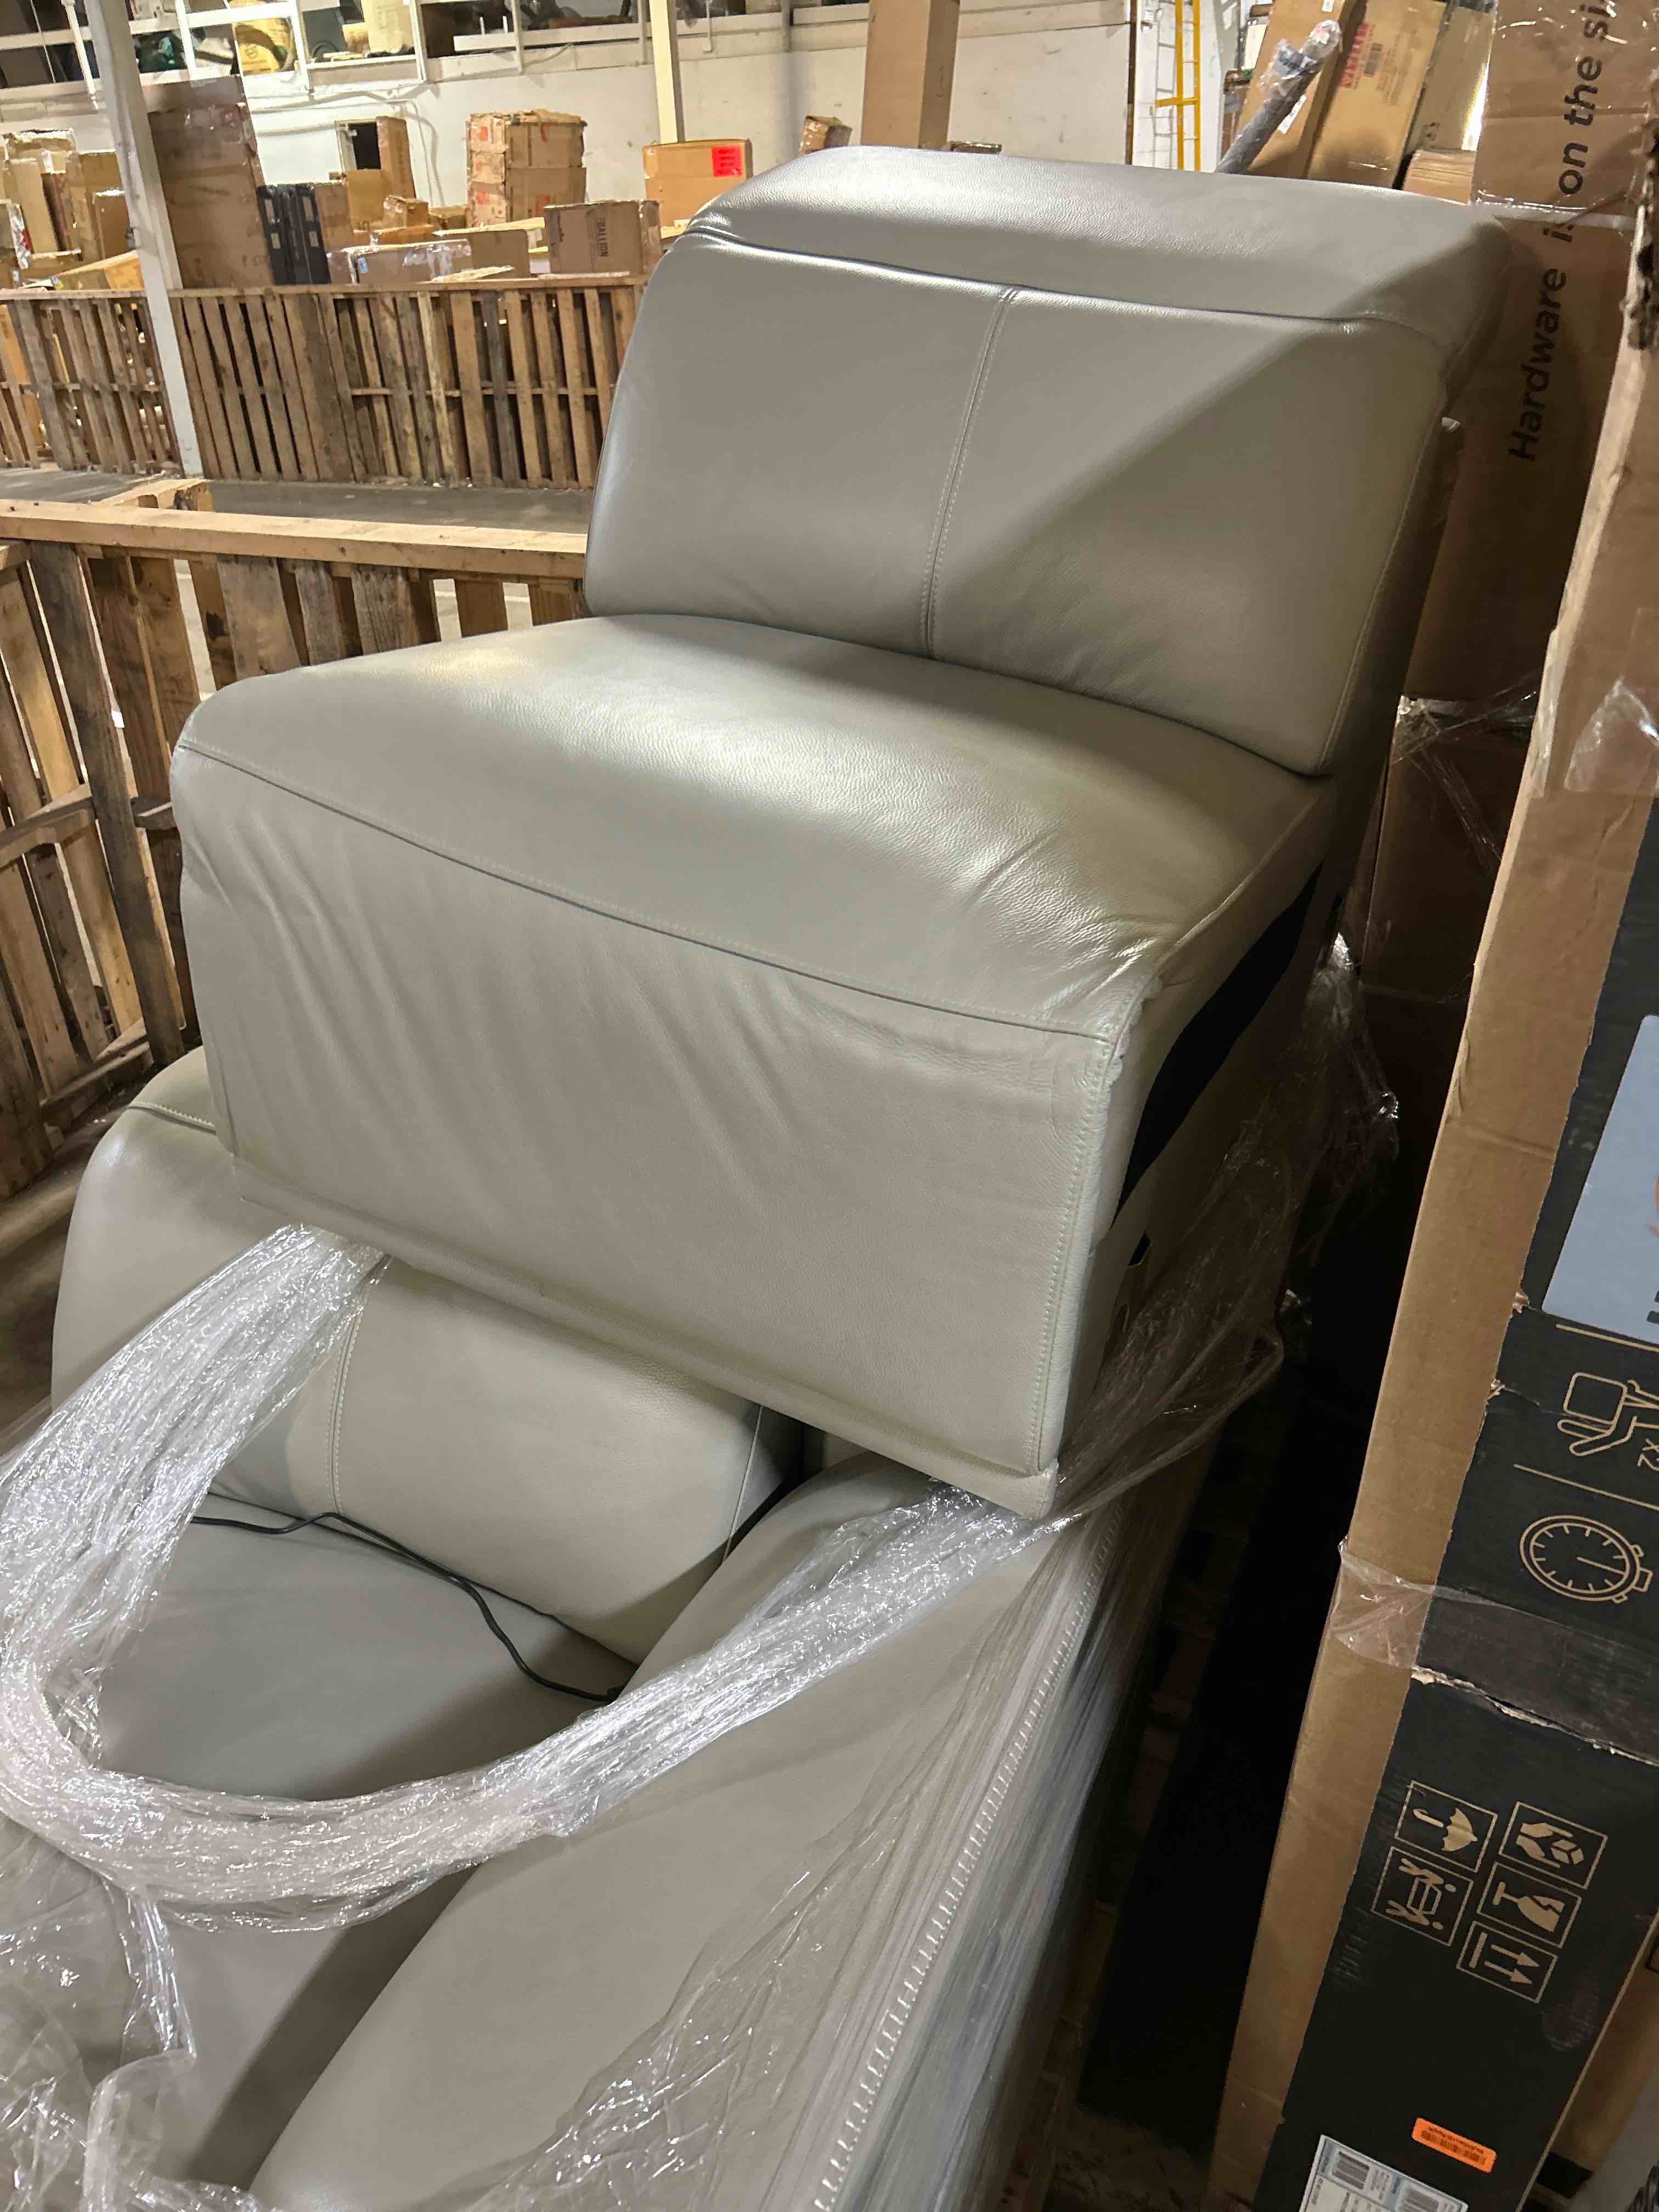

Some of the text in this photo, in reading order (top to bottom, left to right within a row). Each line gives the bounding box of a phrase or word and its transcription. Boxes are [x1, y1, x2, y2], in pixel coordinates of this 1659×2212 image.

[1580, 0, 1610, 42] si
[1564, 55, 1602, 126] the
[1559, 142, 1589, 195] on
[1509, 268, 1566, 461] Hardware
